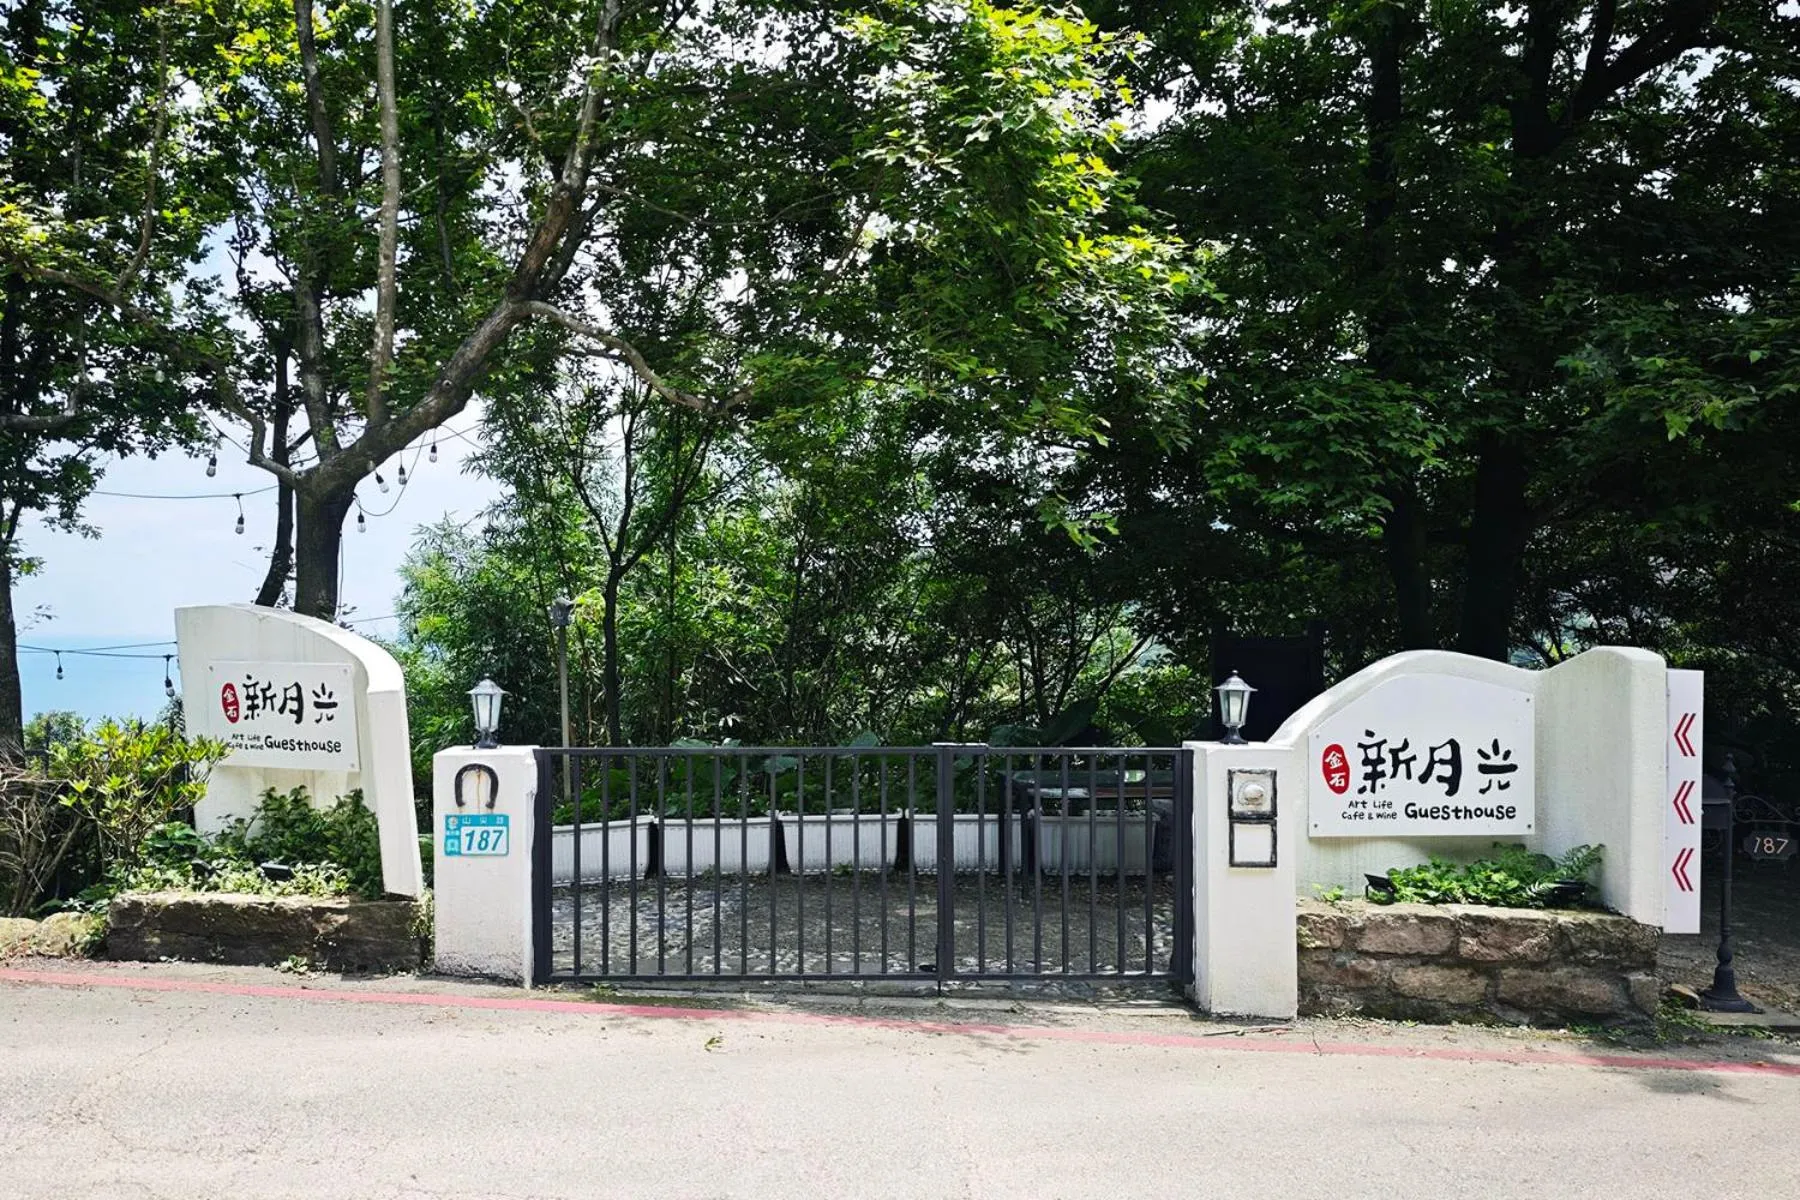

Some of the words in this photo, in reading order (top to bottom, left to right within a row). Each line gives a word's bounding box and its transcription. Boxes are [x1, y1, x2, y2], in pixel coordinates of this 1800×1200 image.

[232, 733, 244, 741] Art
[264, 735, 342, 753] Guesthouse
[1325, 750, 1346, 787] 金石
[1348, 800, 1368, 809] Art
[1373, 800, 1393, 809] Life
[1404, 802, 1516, 820] Guesthouse
[1341, 810, 1365, 820] Cafe
[1367, 812, 1374, 820] &
[1376, 811, 1397, 820] Wine
[465, 830, 504, 851] 187
[1753, 837, 1789, 854] 187
